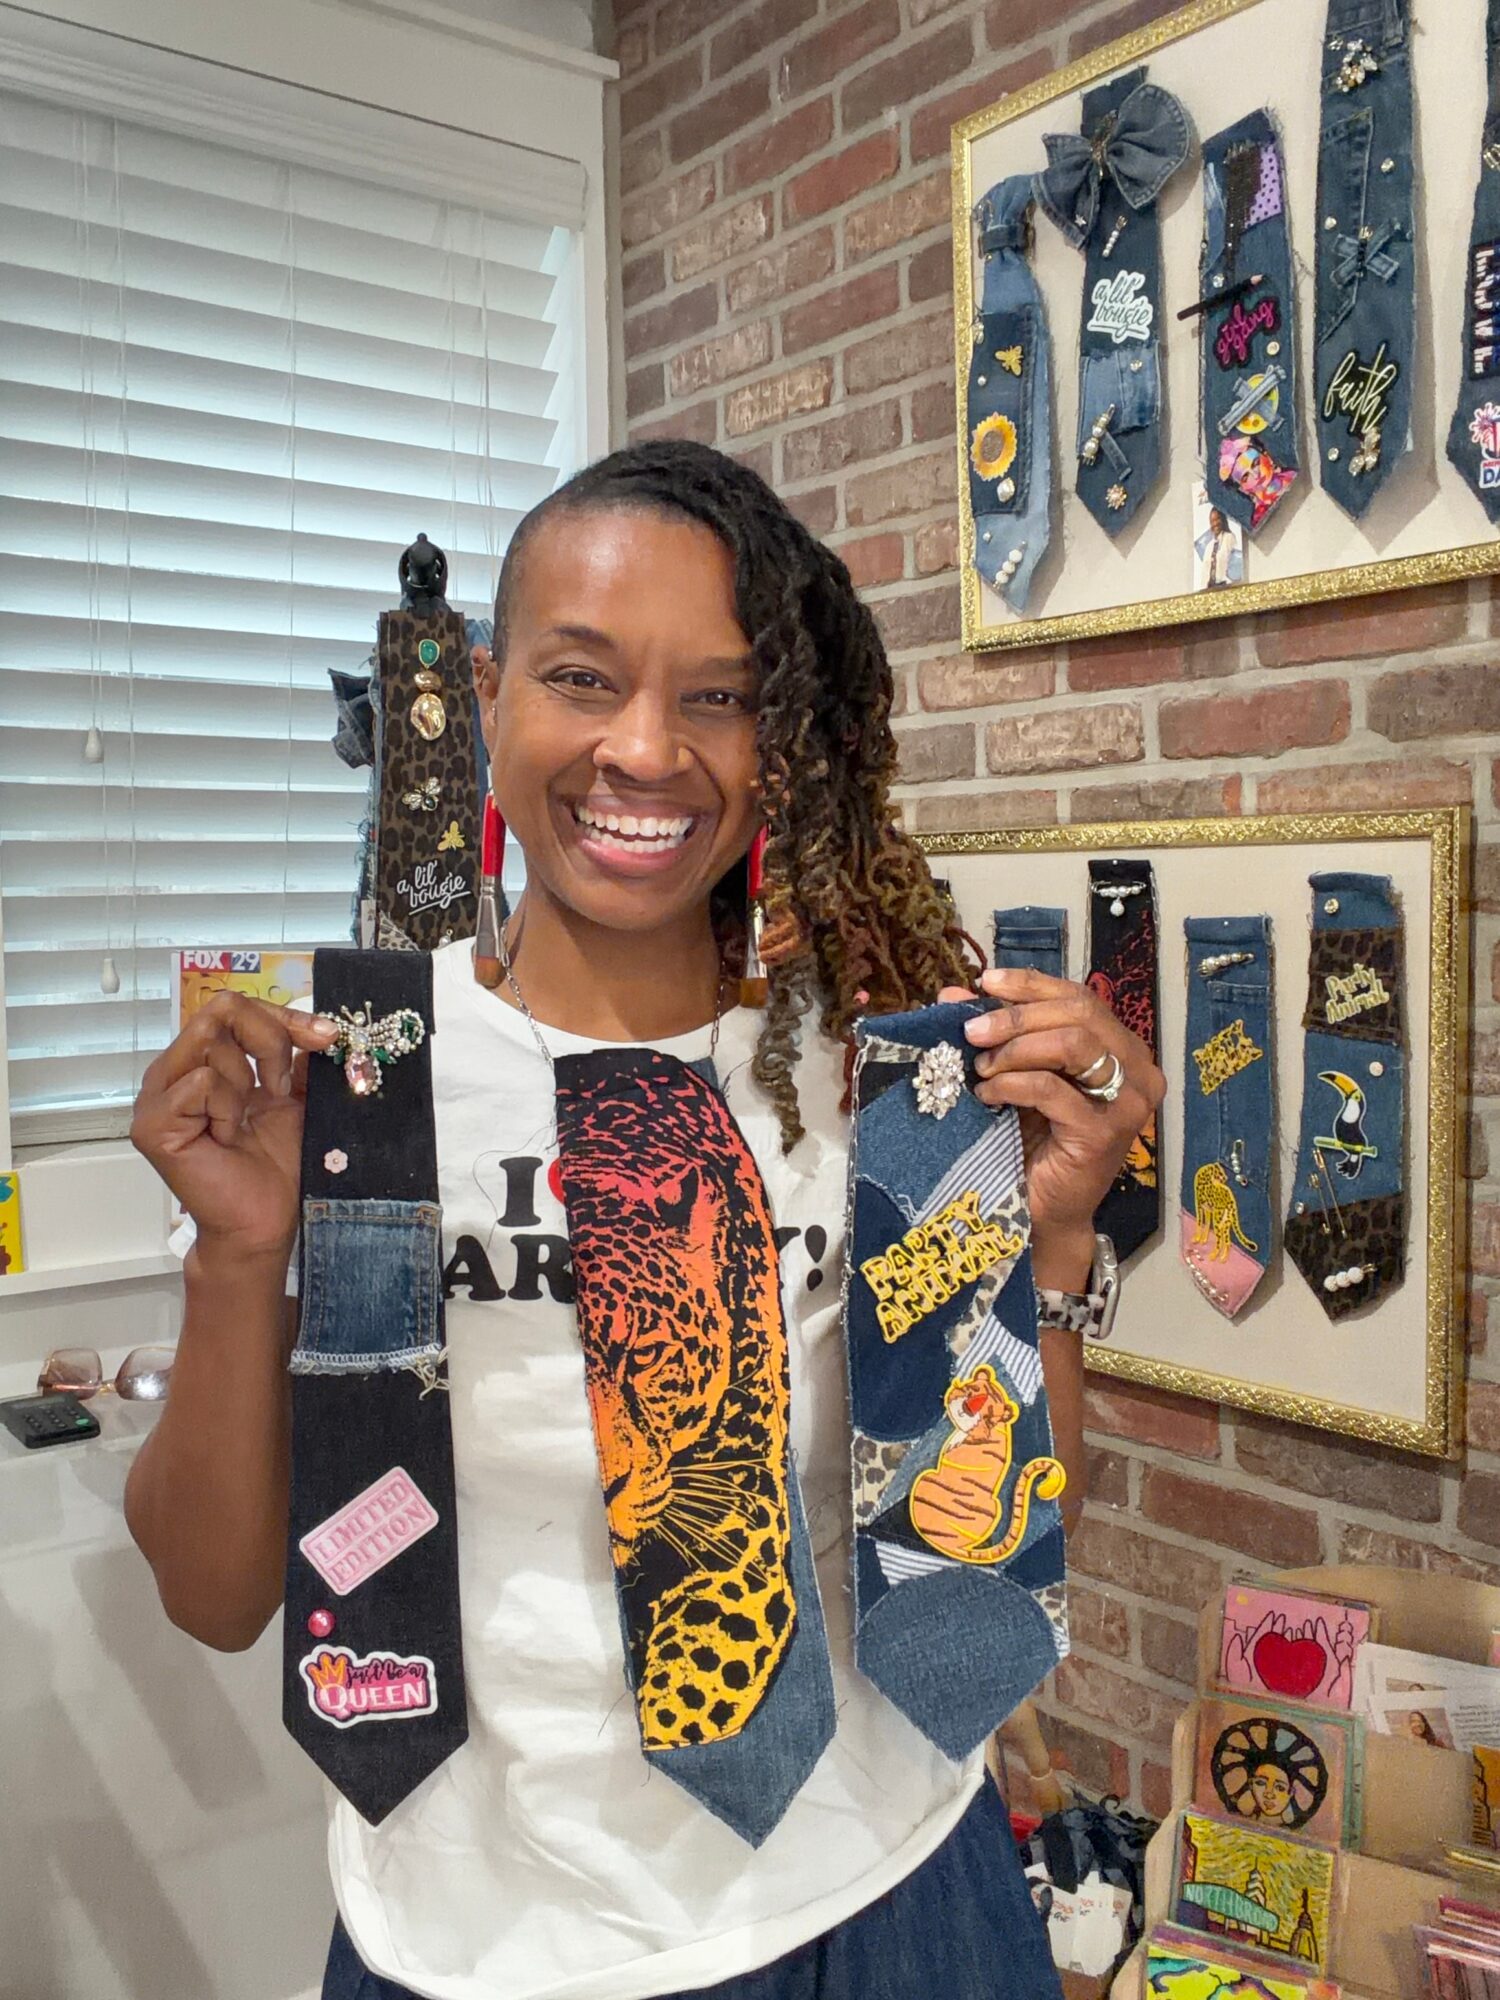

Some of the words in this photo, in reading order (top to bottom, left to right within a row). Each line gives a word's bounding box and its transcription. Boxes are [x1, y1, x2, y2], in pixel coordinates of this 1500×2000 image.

[1096, 299, 1150, 338] bougie
[1217, 303, 1246, 365] girl
[1233, 302, 1275, 361] gang
[1324, 343, 1397, 434] faith
[396, 879, 411, 894] a
[414, 859, 438, 889] lil'
[409, 871, 467, 909] bougie
[183, 950, 224, 970] FOX
[231, 952, 260, 971] 29
[1325, 978, 1390, 1025] Animal
[497, 1156, 544, 1227] I
[860, 1190, 983, 1301] PARTY
[876, 1223, 1024, 1345] ANIMAL
[314, 1481, 408, 1562] LIMITED
[330, 1500, 427, 1584] EDITION
[346, 1660, 383, 1689] just
[383, 1660, 408, 1680] be
